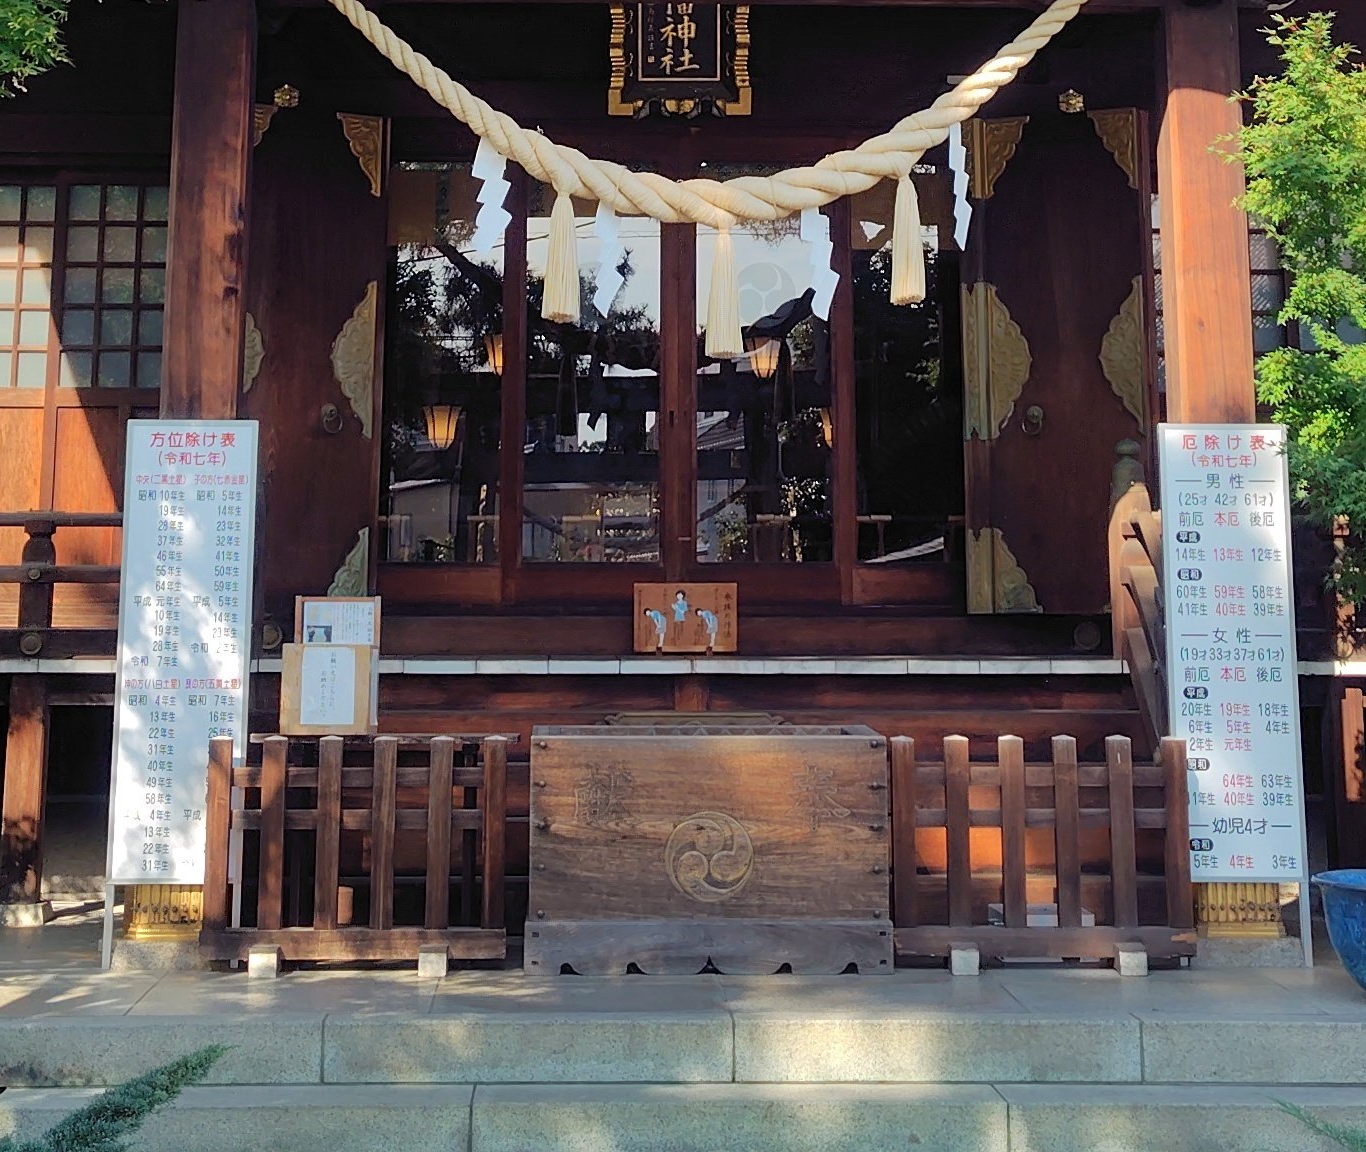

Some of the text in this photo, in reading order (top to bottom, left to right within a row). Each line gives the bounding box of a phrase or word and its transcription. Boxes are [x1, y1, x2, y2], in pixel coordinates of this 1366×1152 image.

[149, 432, 235, 447] 方位除け表
[1181, 435, 1266, 451] 厄除け表
[158, 451, 226, 466] (令和七年)
[1190, 452, 1257, 467] (令和七年)
[1206, 474, 1244, 489] 男性
[138, 490, 185, 501] 昭和 10年生
[195, 491, 242, 501] 昭和 5年生
[158, 505, 184, 516] 19年生
[217, 506, 242, 516] 14年生
[1178, 513, 1274, 526] 前厄 本厄 後厄
[215, 521, 241, 531] 23年生
[156, 536, 183, 546] 37年生
[215, 536, 240, 546] 32年生
[1178, 532, 1198, 542] 平成
[156, 551, 182, 561] 46年生
[215, 551, 239, 561] 41年生
[1175, 548, 1281, 561] 14年生 13年生 12年生
[155, 566, 181, 577] 55年生
[213, 566, 239, 577] 50年生
[1179, 569, 1199, 580] 昭和
[154, 581, 181, 592] 64年生
[1176, 586, 1283, 599] 60年生 59年生 58年生
[133, 596, 180, 607] 平成 元年生
[192, 596, 238, 607] 平成 5年生
[1177, 603, 1284, 616] 41年生 40年生 39年生
[154, 610, 180, 621] 10年生
[213, 612, 237, 622] 14年生
[153, 626, 179, 636] 19年生
[1212, 628, 1251, 643] 女性
[190, 643, 208, 653] 令和
[130, 656, 178, 667] 令和 7年生
[1183, 667, 1282, 682] 前厄 本厄 後厄
[1185, 687, 1206, 698] 平成
[128, 695, 176, 706] 昭和 4年生
[188, 695, 235, 706] 昭和 7年生
[1181, 703, 1289, 716] 20年生 19年生 18年生
[149, 711, 176, 722] 13年生
[208, 711, 234, 722] 16年生
[148, 728, 175, 738] 22年生
[1188, 721, 1290, 734] 6年生 5年生 4年生
[147, 744, 174, 755] 31年生
[1188, 738, 1251, 751] 2年生 元年生
[146, 760, 173, 772] 40年生
[145, 777, 172, 788] 49年生
[1222, 775, 1292, 788] 64年生 63年生
[144, 793, 171, 804] 58年生
[1187, 792, 1293, 806] 1年生 40年生 39年生
[183, 809, 201, 820] 平成
[144, 826, 170, 837] 13年生
[1212, 818, 1267, 834] 幼児4才
[142, 843, 169, 854] 22年生
[1191, 840, 1210, 850] 令和
[141, 859, 169, 871] 31年生
[1193, 855, 1297, 869] 5年生 4年生 3年生
